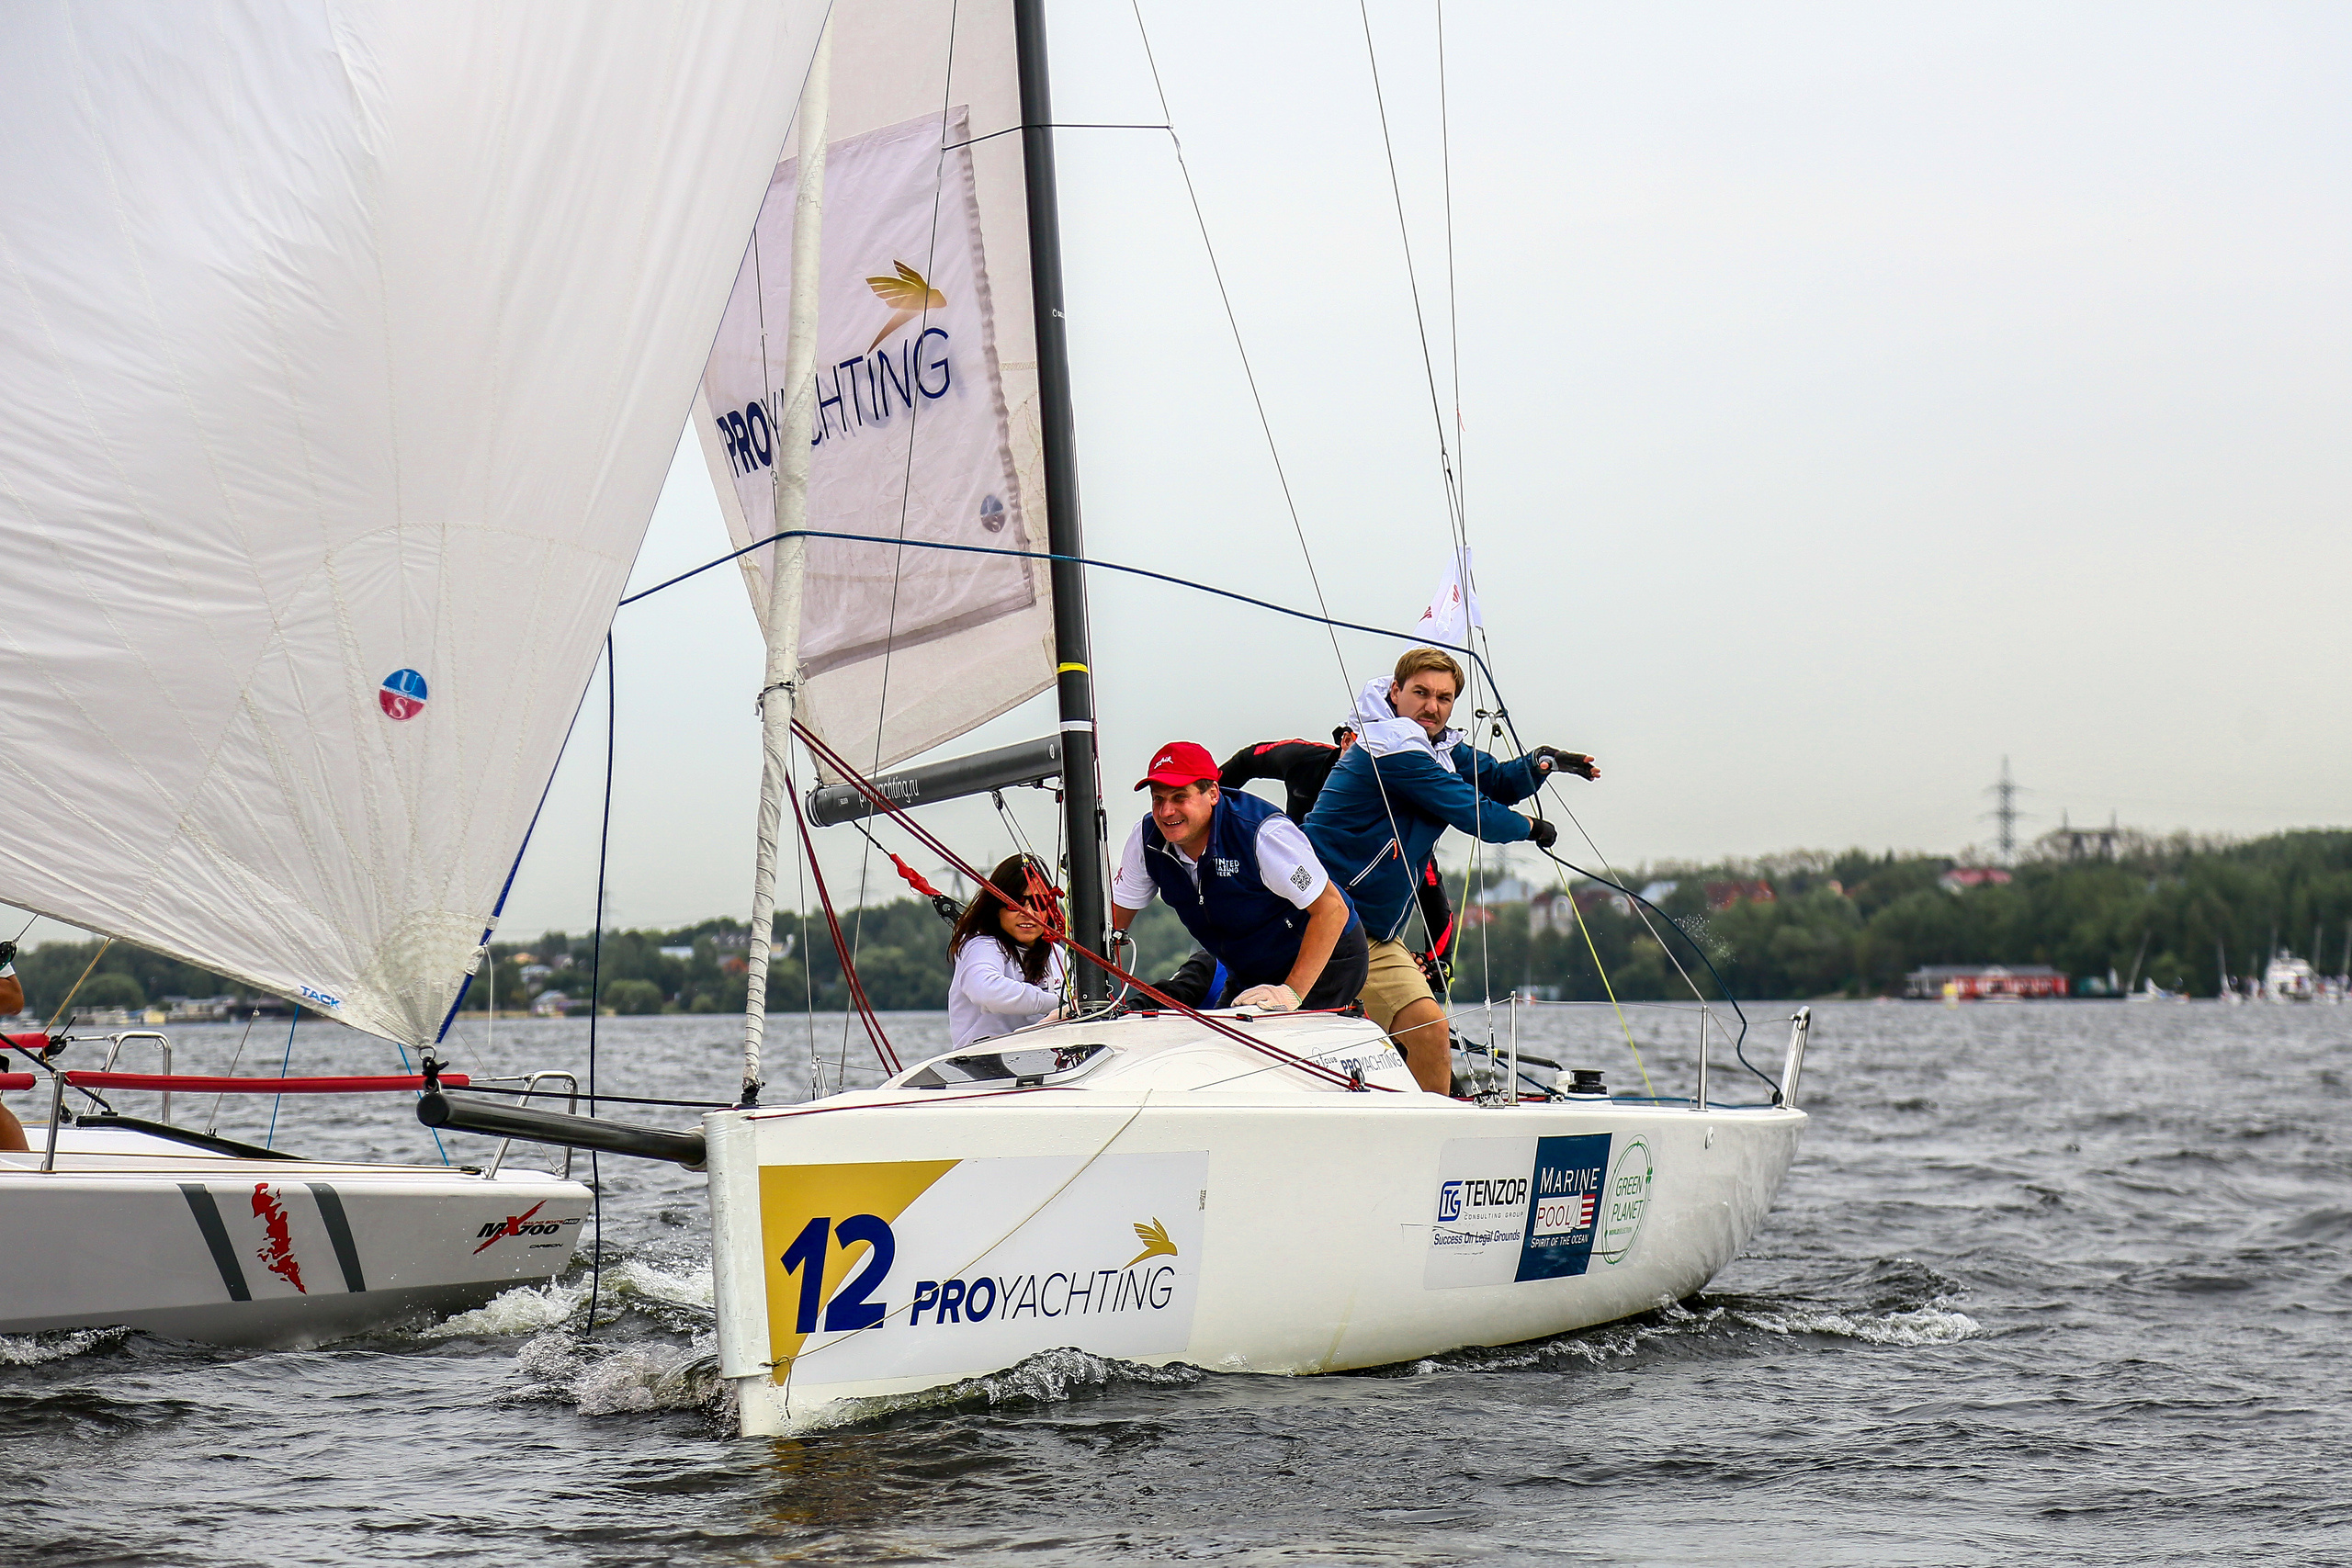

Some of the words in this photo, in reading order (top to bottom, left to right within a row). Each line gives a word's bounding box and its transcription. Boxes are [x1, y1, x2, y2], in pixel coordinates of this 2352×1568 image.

[717, 327, 951, 479] PROYHTING
[300, 985, 341, 1010] TACK
[1340, 1052, 1403, 1075] PROYACHTING
[1464, 1178, 1528, 1207] TENZOR
[1539, 1167, 1600, 1194] MARINE
[1615, 1175, 1644, 1197] GREEN
[1464, 1213, 1502, 1221] CONSULTING
[1535, 1204, 1570, 1229] POOL
[1611, 1200, 1644, 1223] PLANET
[1433, 1233, 1463, 1246] Success
[1464, 1232, 1474, 1244] On
[1475, 1231, 1493, 1246] Legal
[1494, 1229, 1521, 1242] Grounds
[1530, 1236, 1550, 1248] SPIRIT
[1550, 1236, 1558, 1247] OF
[1559, 1235, 1570, 1246] THE
[1571, 1234, 1589, 1245] OCEAN
[780, 1213, 895, 1334] 12
[910, 1266, 1176, 1326] PROYACHTING
